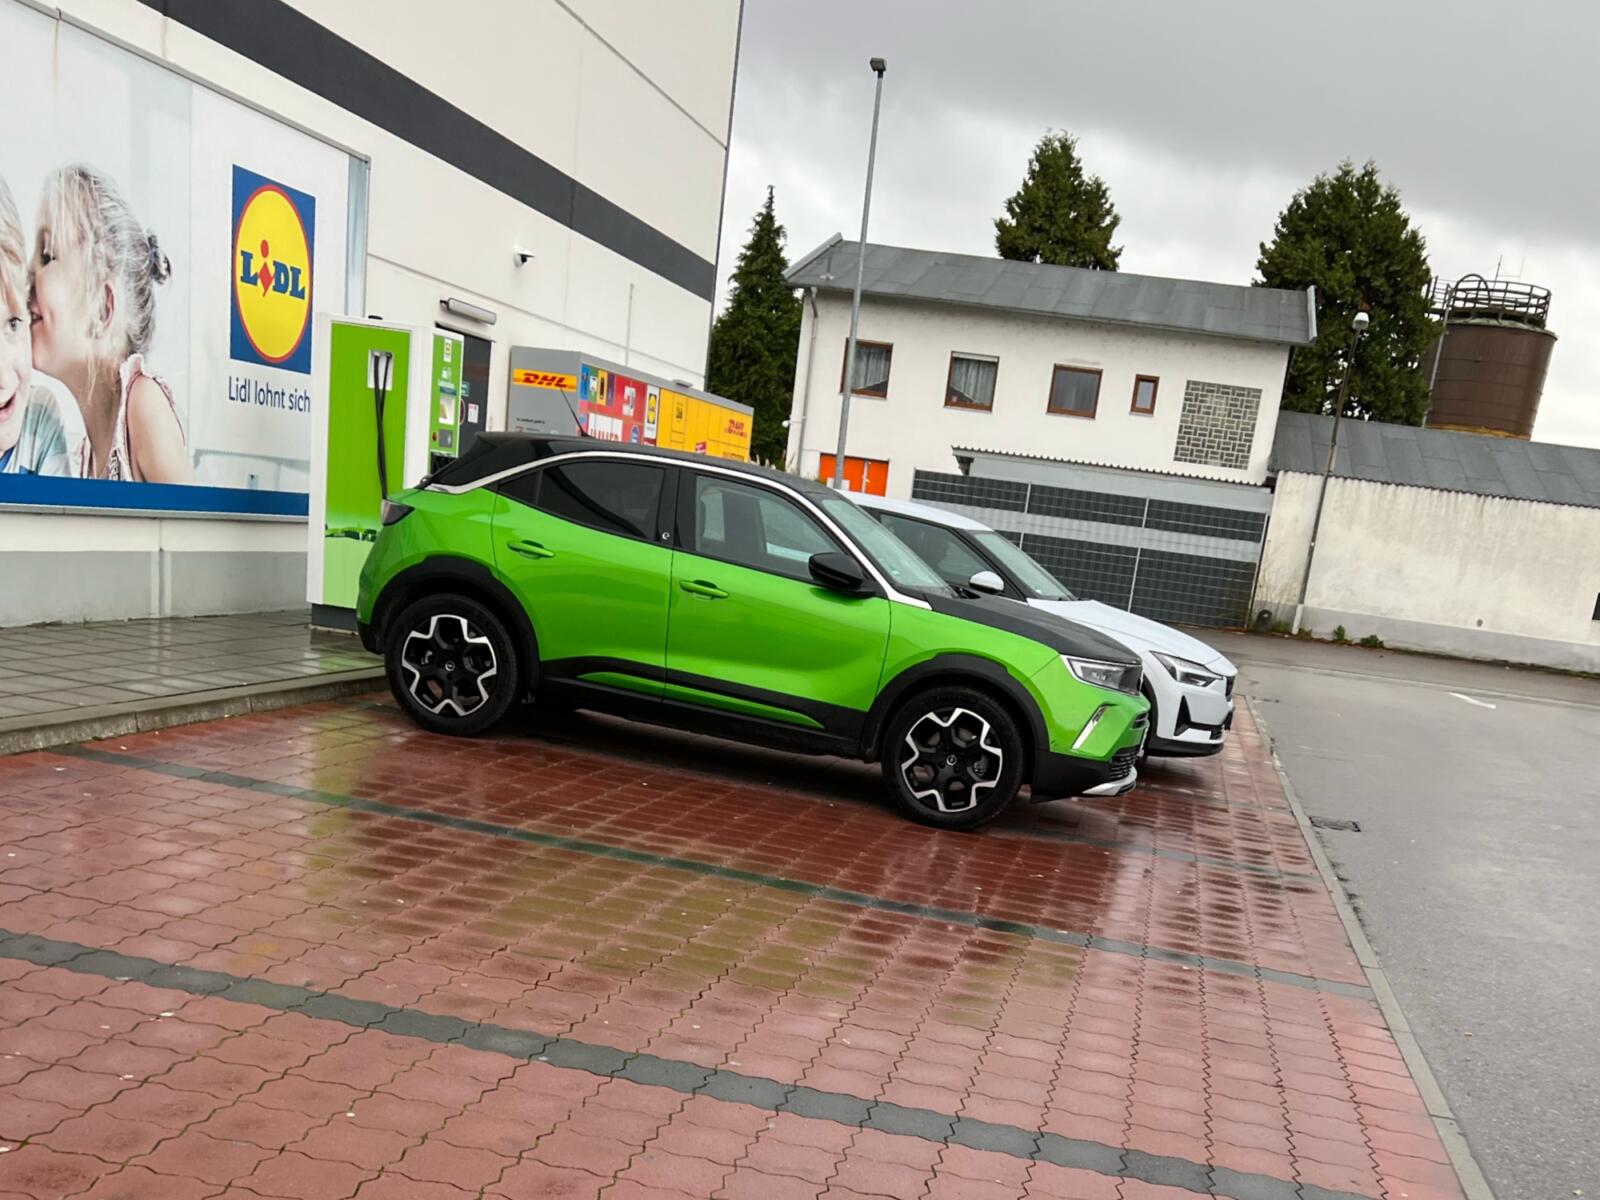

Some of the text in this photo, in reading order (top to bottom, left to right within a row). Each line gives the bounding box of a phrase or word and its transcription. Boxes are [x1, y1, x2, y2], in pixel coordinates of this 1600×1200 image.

[228, 375, 311, 413] Lidl lohnt sich
[522, 372, 568, 389] DHL
